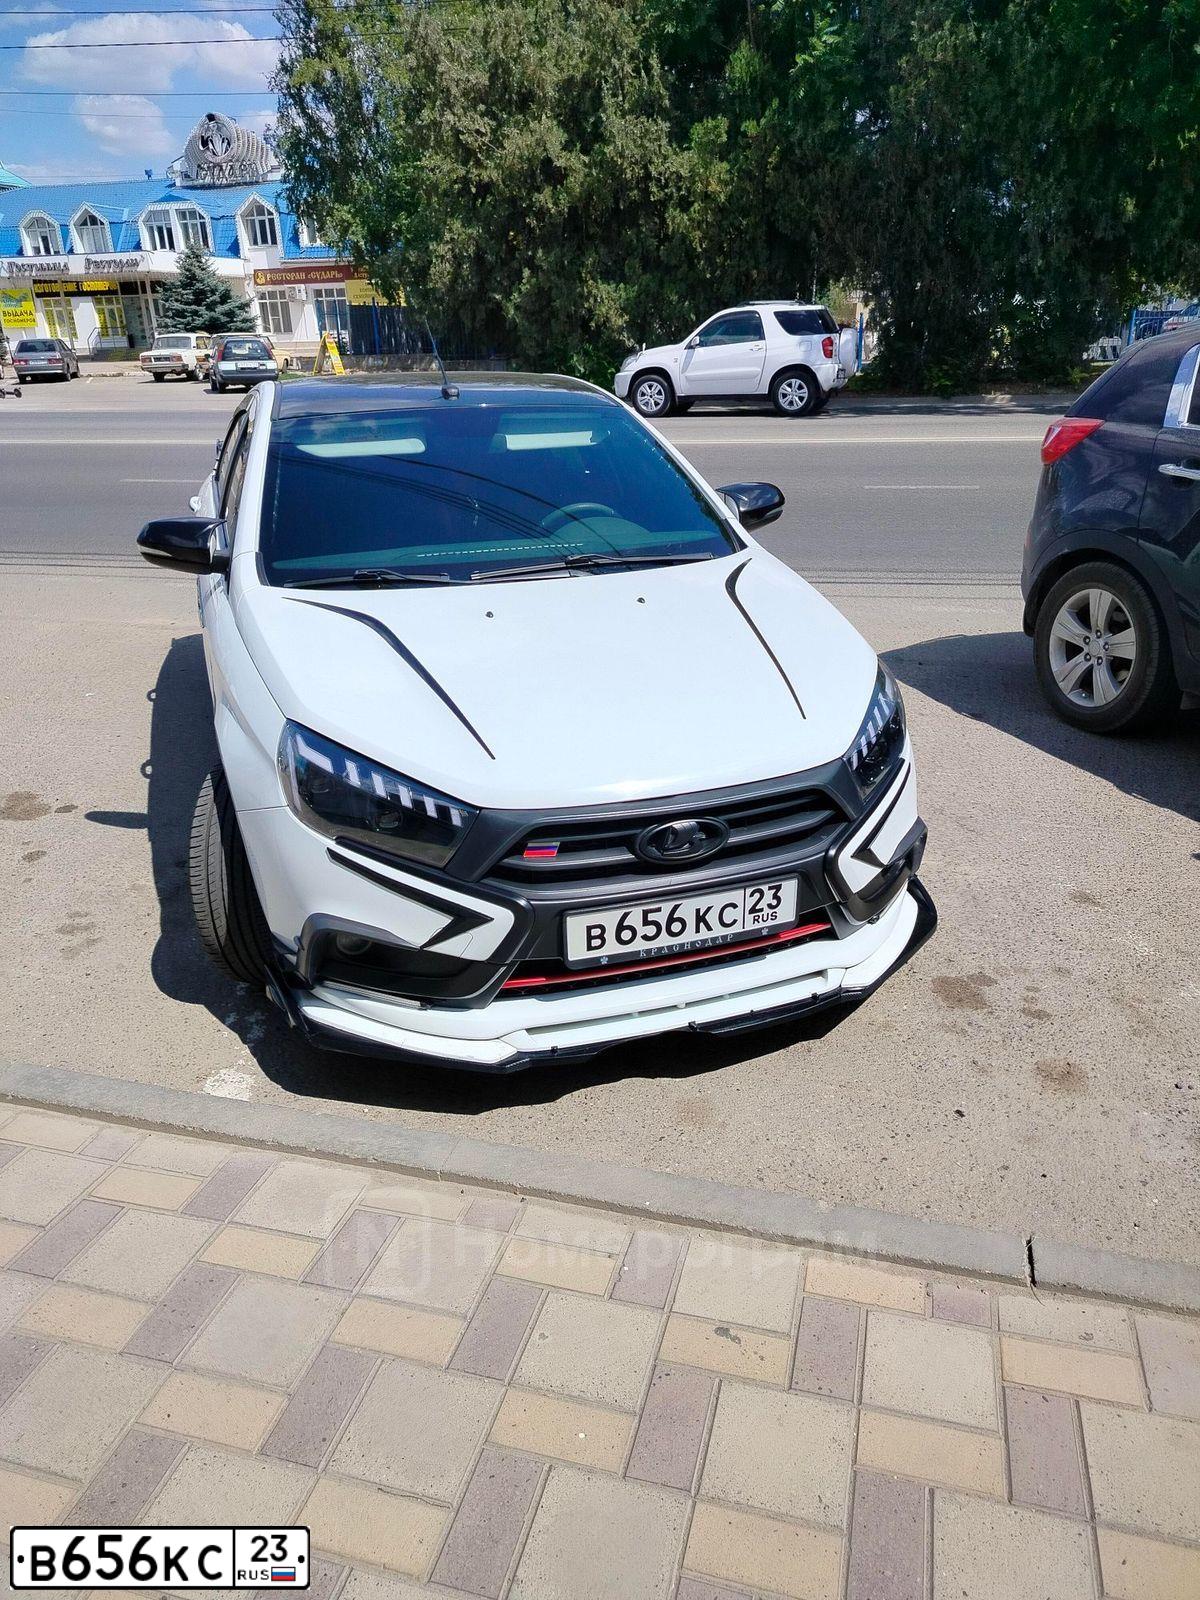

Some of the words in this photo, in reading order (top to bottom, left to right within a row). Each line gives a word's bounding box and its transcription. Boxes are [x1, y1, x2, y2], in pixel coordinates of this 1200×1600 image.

[266, 272, 306, 281] РЕСТОРАН
[748, 883, 783, 915] 23
[753, 911, 778, 925] RUS
[639, 933, 734, 958] КРАСНОДАР
